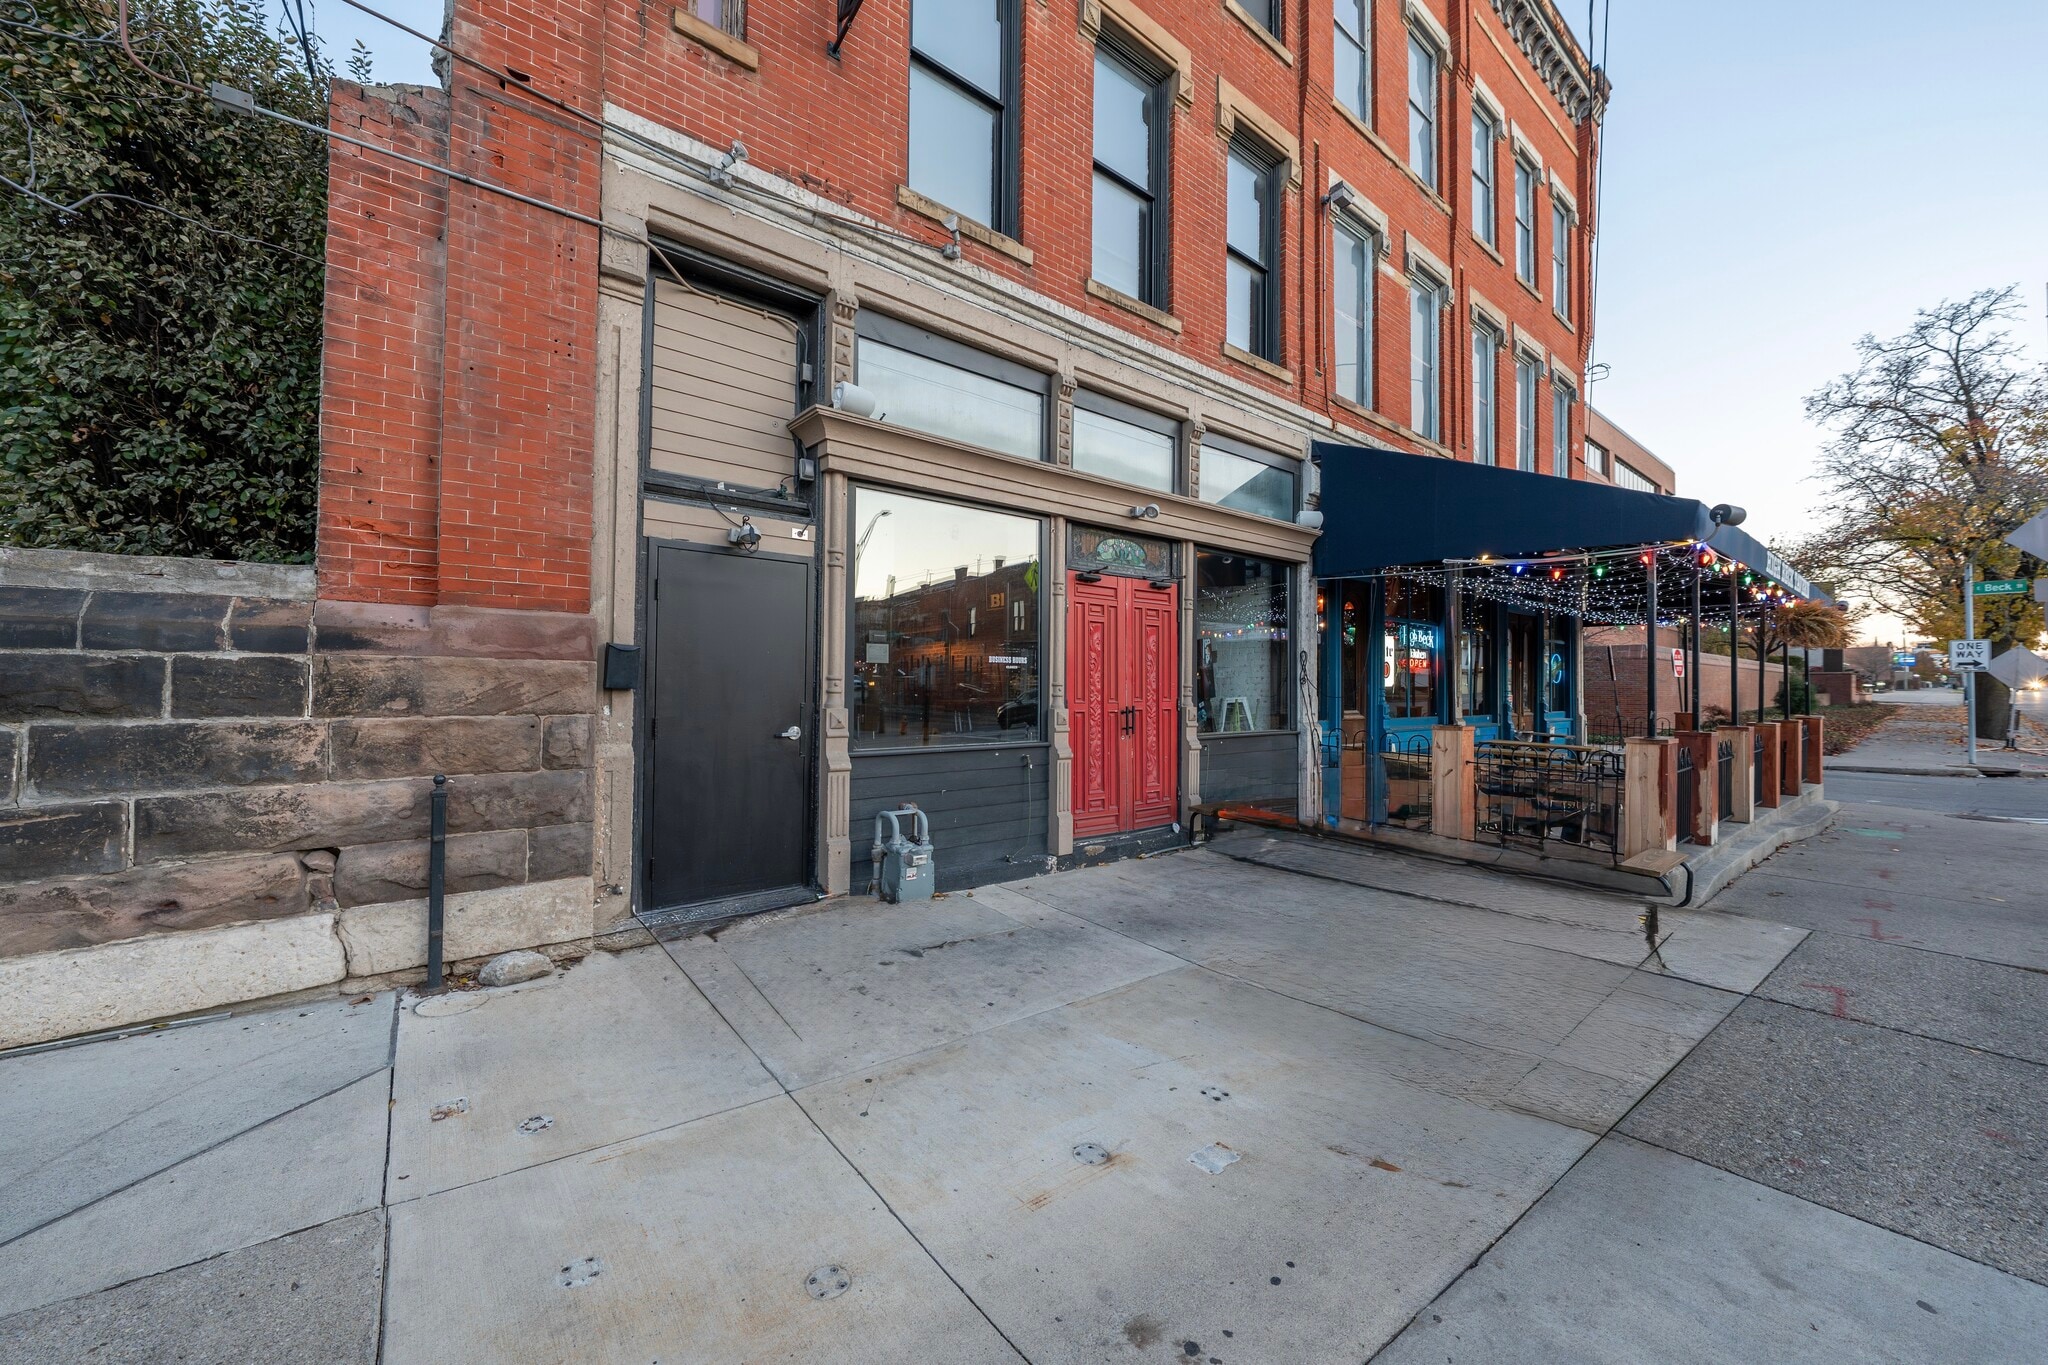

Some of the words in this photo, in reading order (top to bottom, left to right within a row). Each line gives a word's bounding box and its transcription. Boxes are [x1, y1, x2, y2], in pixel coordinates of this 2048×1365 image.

[1984, 583, 2012, 592] Beck
[1956, 642, 1984, 650] ONE
[1955, 650, 1984, 658] WAY
[1410, 659, 1427, 668] OPEN
